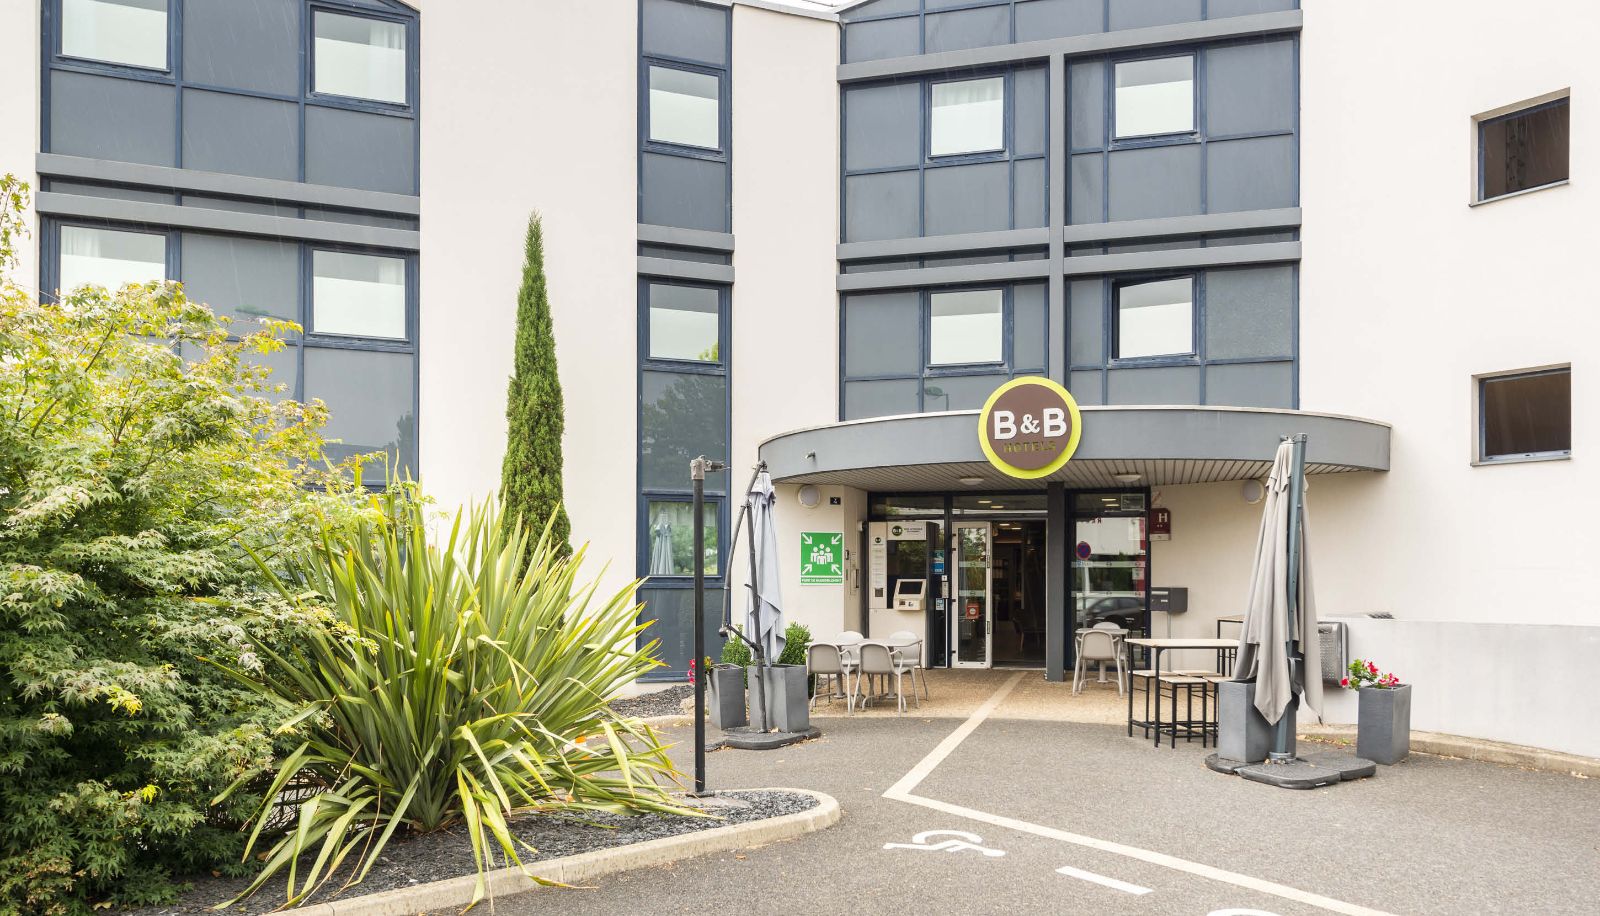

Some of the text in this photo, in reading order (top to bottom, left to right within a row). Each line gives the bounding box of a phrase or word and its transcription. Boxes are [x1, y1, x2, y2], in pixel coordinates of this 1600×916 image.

[994, 407, 1067, 440] B&B
[1003, 441, 1056, 453] HOTELS
[1158, 512, 1168, 523] H
